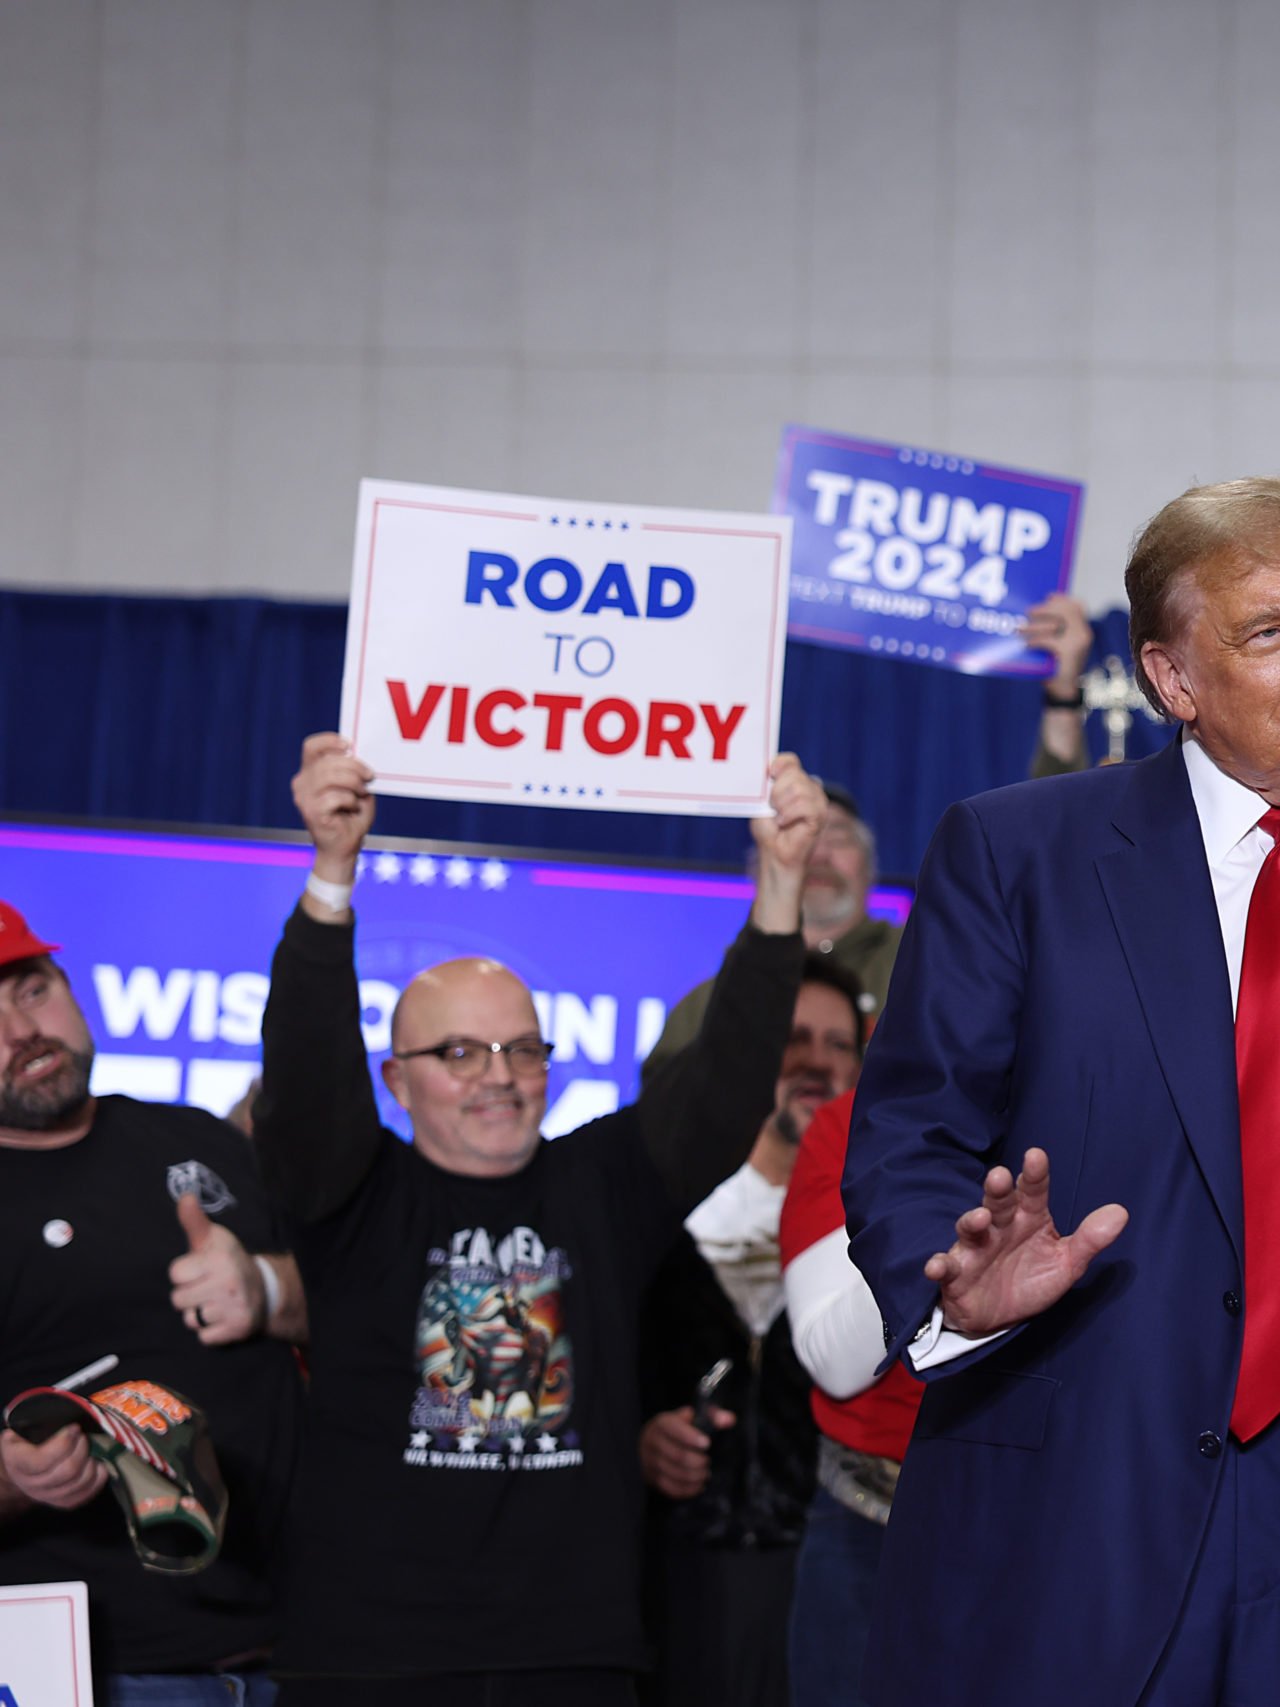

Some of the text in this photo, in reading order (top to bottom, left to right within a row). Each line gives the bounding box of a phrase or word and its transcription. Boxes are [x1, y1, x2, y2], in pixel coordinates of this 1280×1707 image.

[807, 469, 1051, 560] TRUMP
[464, 549, 695, 620] ROAD
[828, 528, 1008, 607] 2024
[544, 633, 615, 677] TO
[386, 678, 747, 761] VICTORY
